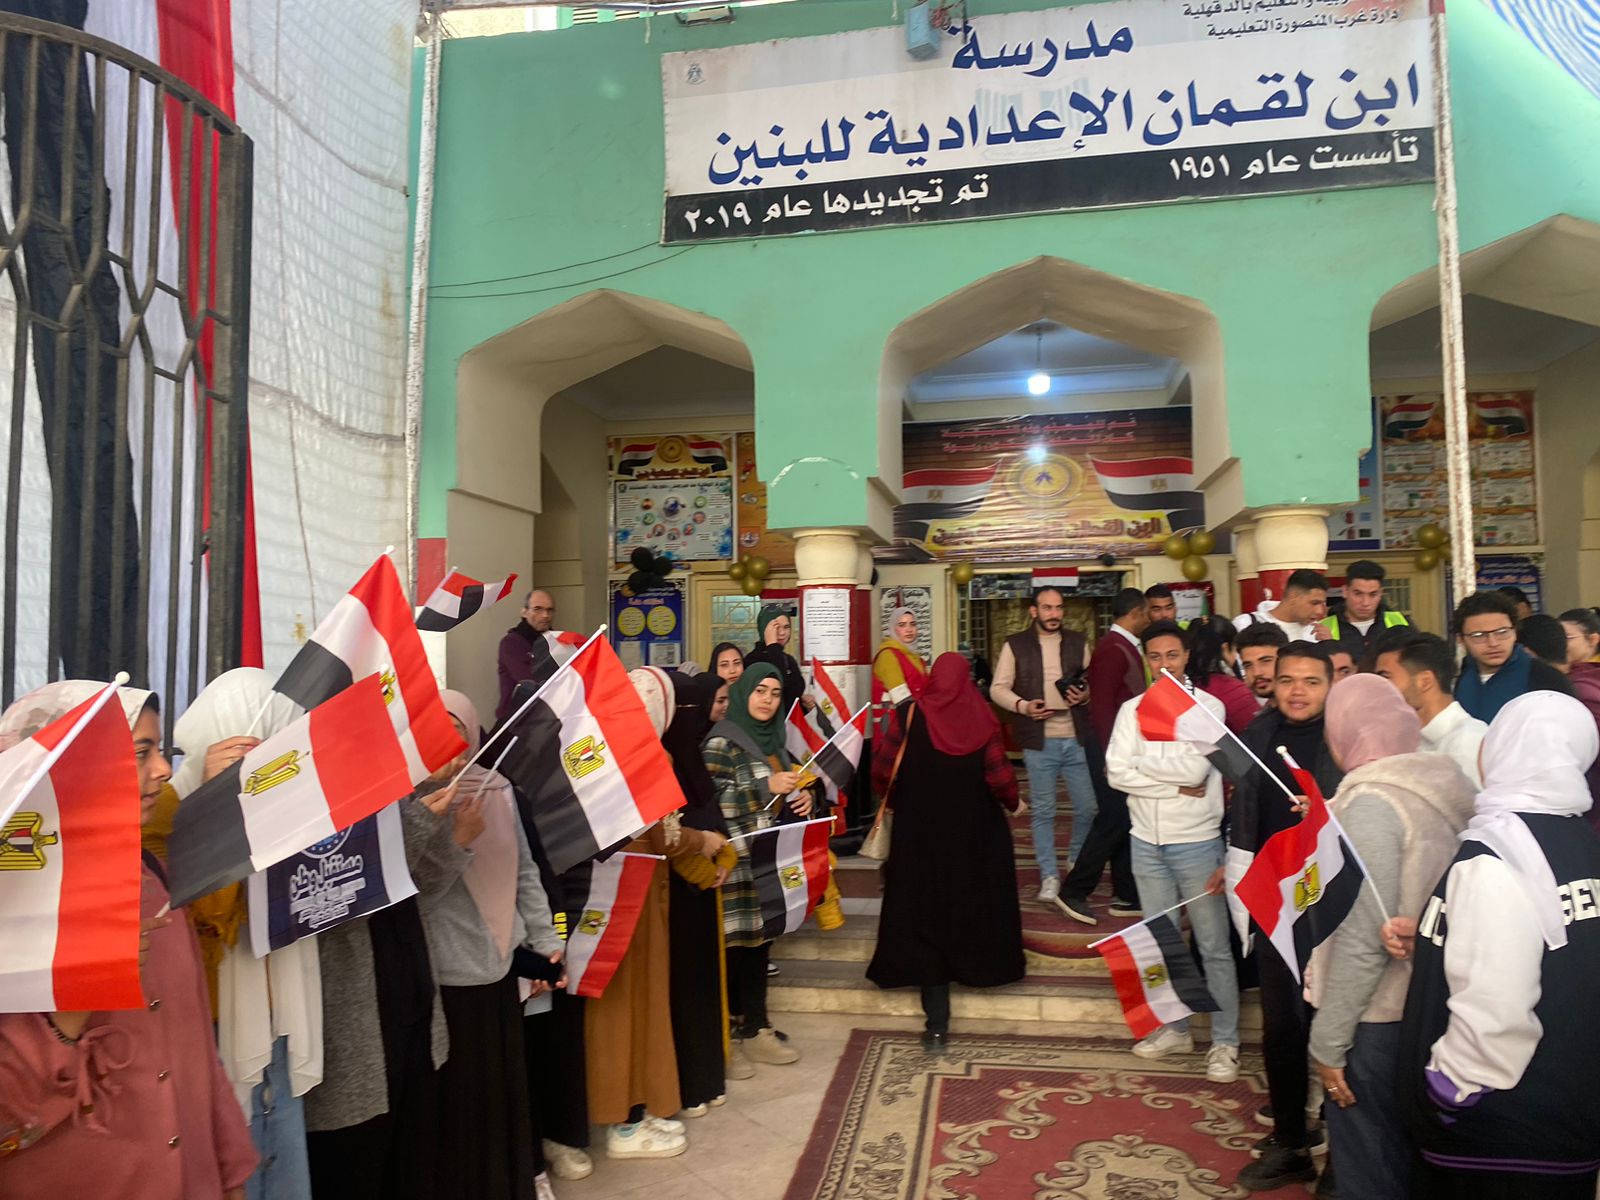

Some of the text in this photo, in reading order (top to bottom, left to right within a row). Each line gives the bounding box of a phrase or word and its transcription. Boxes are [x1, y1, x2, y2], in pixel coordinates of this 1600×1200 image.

[948, 20, 1134, 78] مدرسة
[1207, 19, 1274, 39] التعليمية
[708, 63, 1420, 186] ابن لقمان الإعدادية للبنين
[1169, 130, 1419, 181] تأسست عام ١٩٥١
[684, 173, 989, 233] تم تجديدها عام ٢٠١٩
